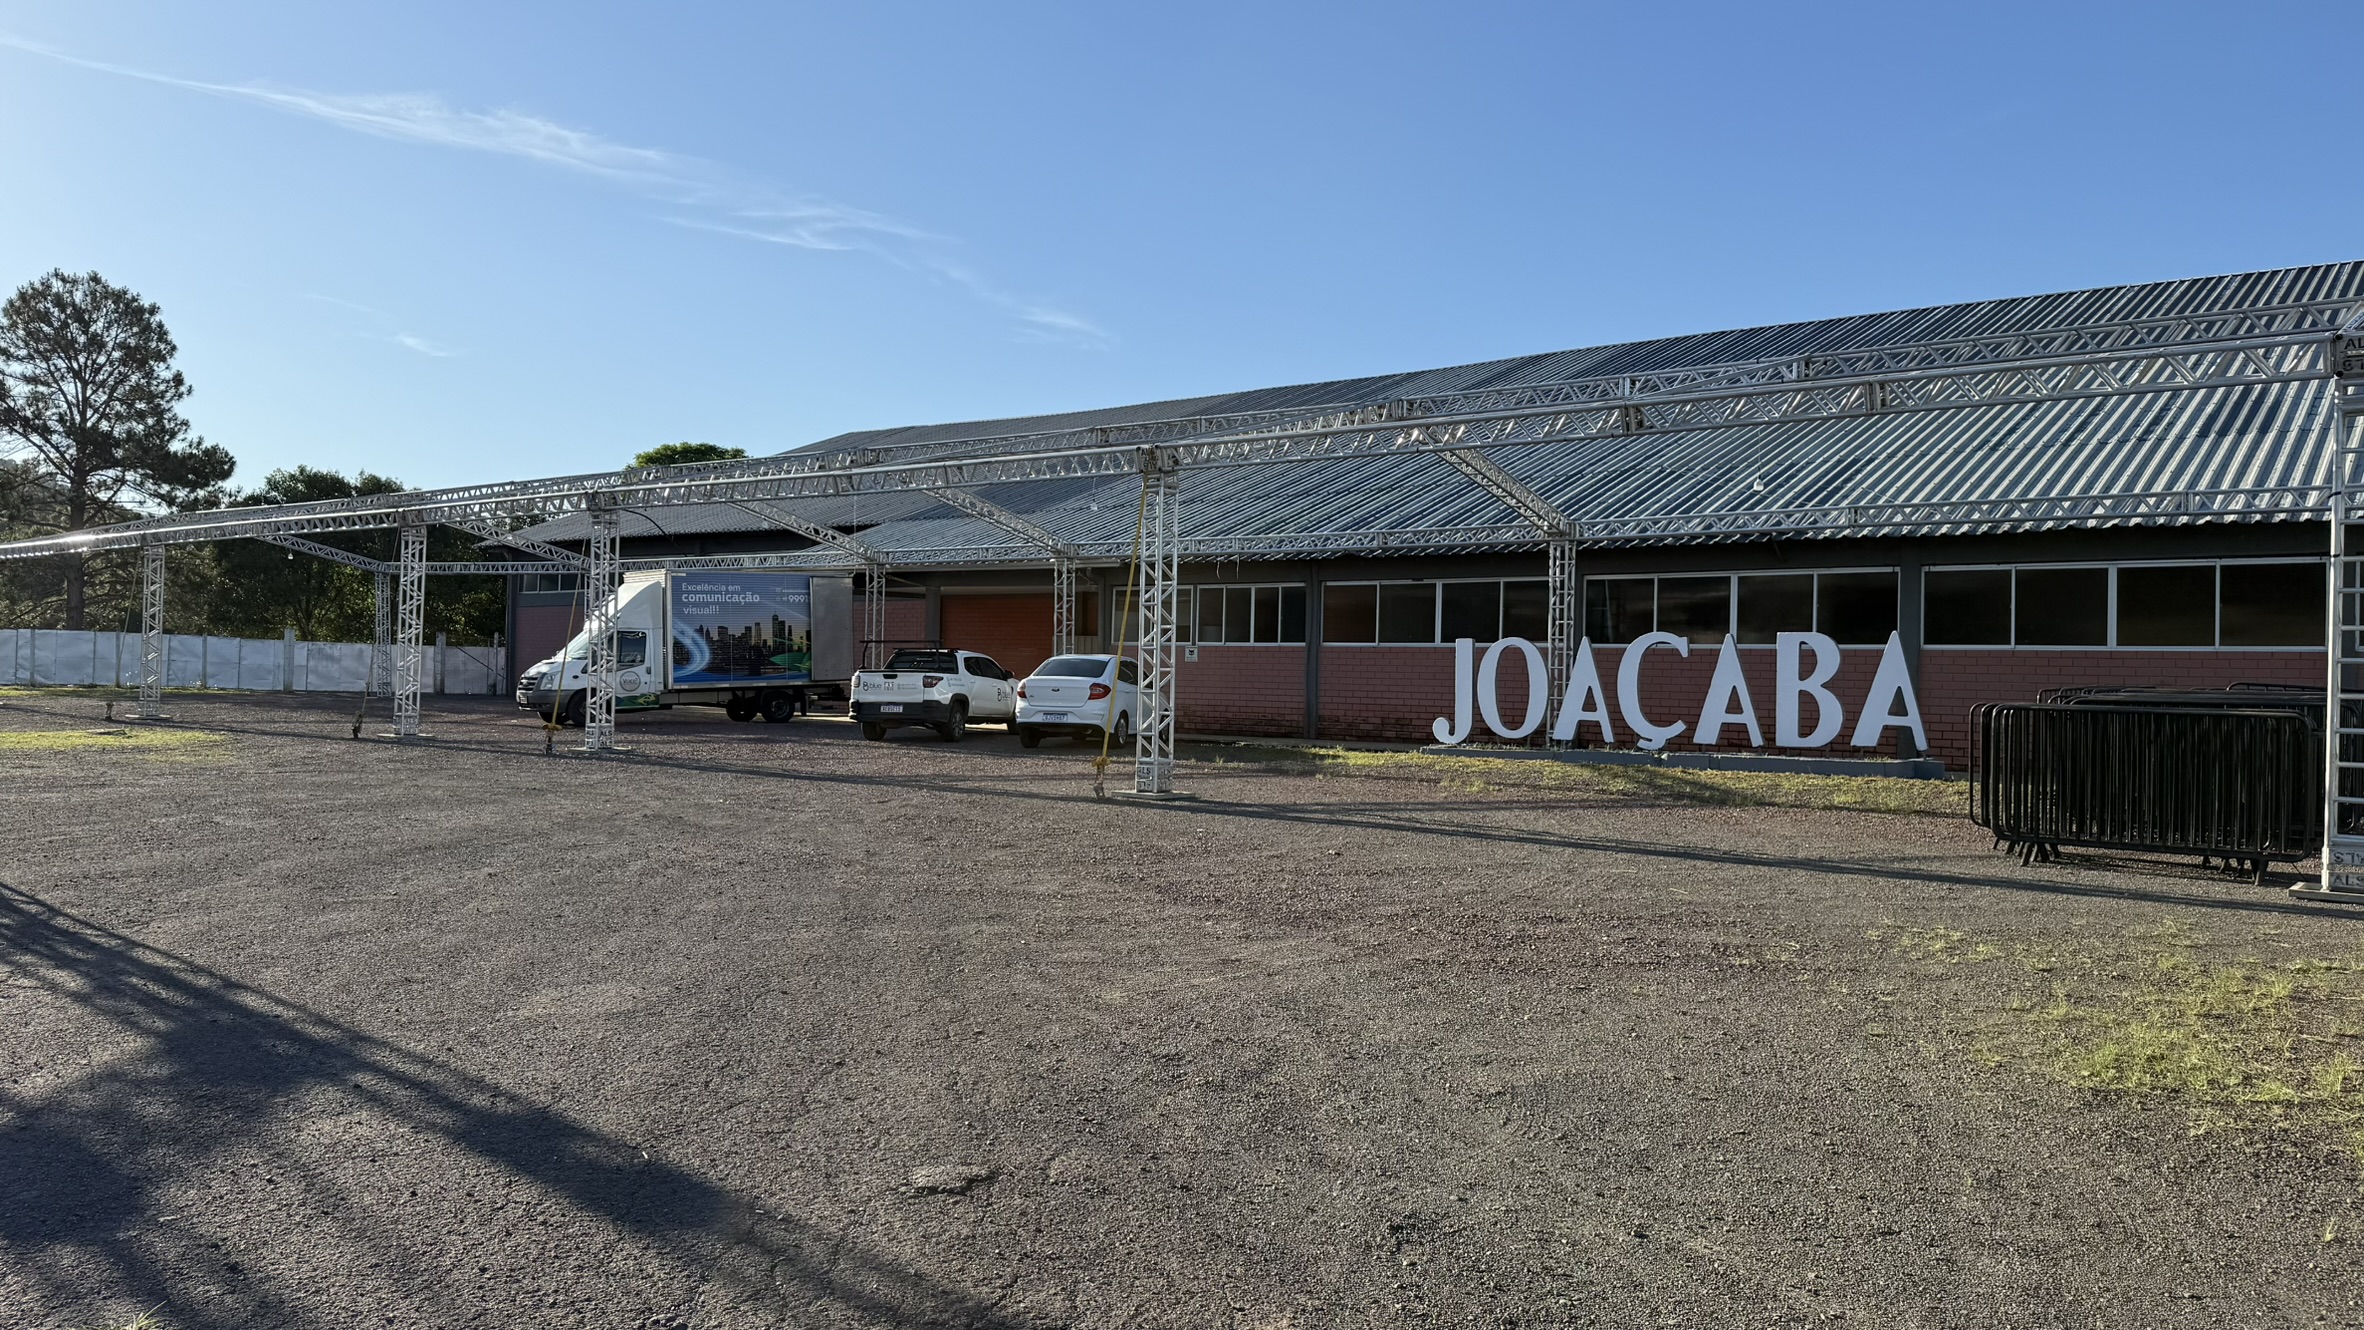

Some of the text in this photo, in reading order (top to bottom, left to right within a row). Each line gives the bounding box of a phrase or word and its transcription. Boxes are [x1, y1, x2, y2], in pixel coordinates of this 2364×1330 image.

[682, 583, 741, 592] Excelência em
[682, 592, 760, 605] comunicação
[683, 605, 719, 614] visual!!
[1432, 630, 1929, 751] JOAÇABA
